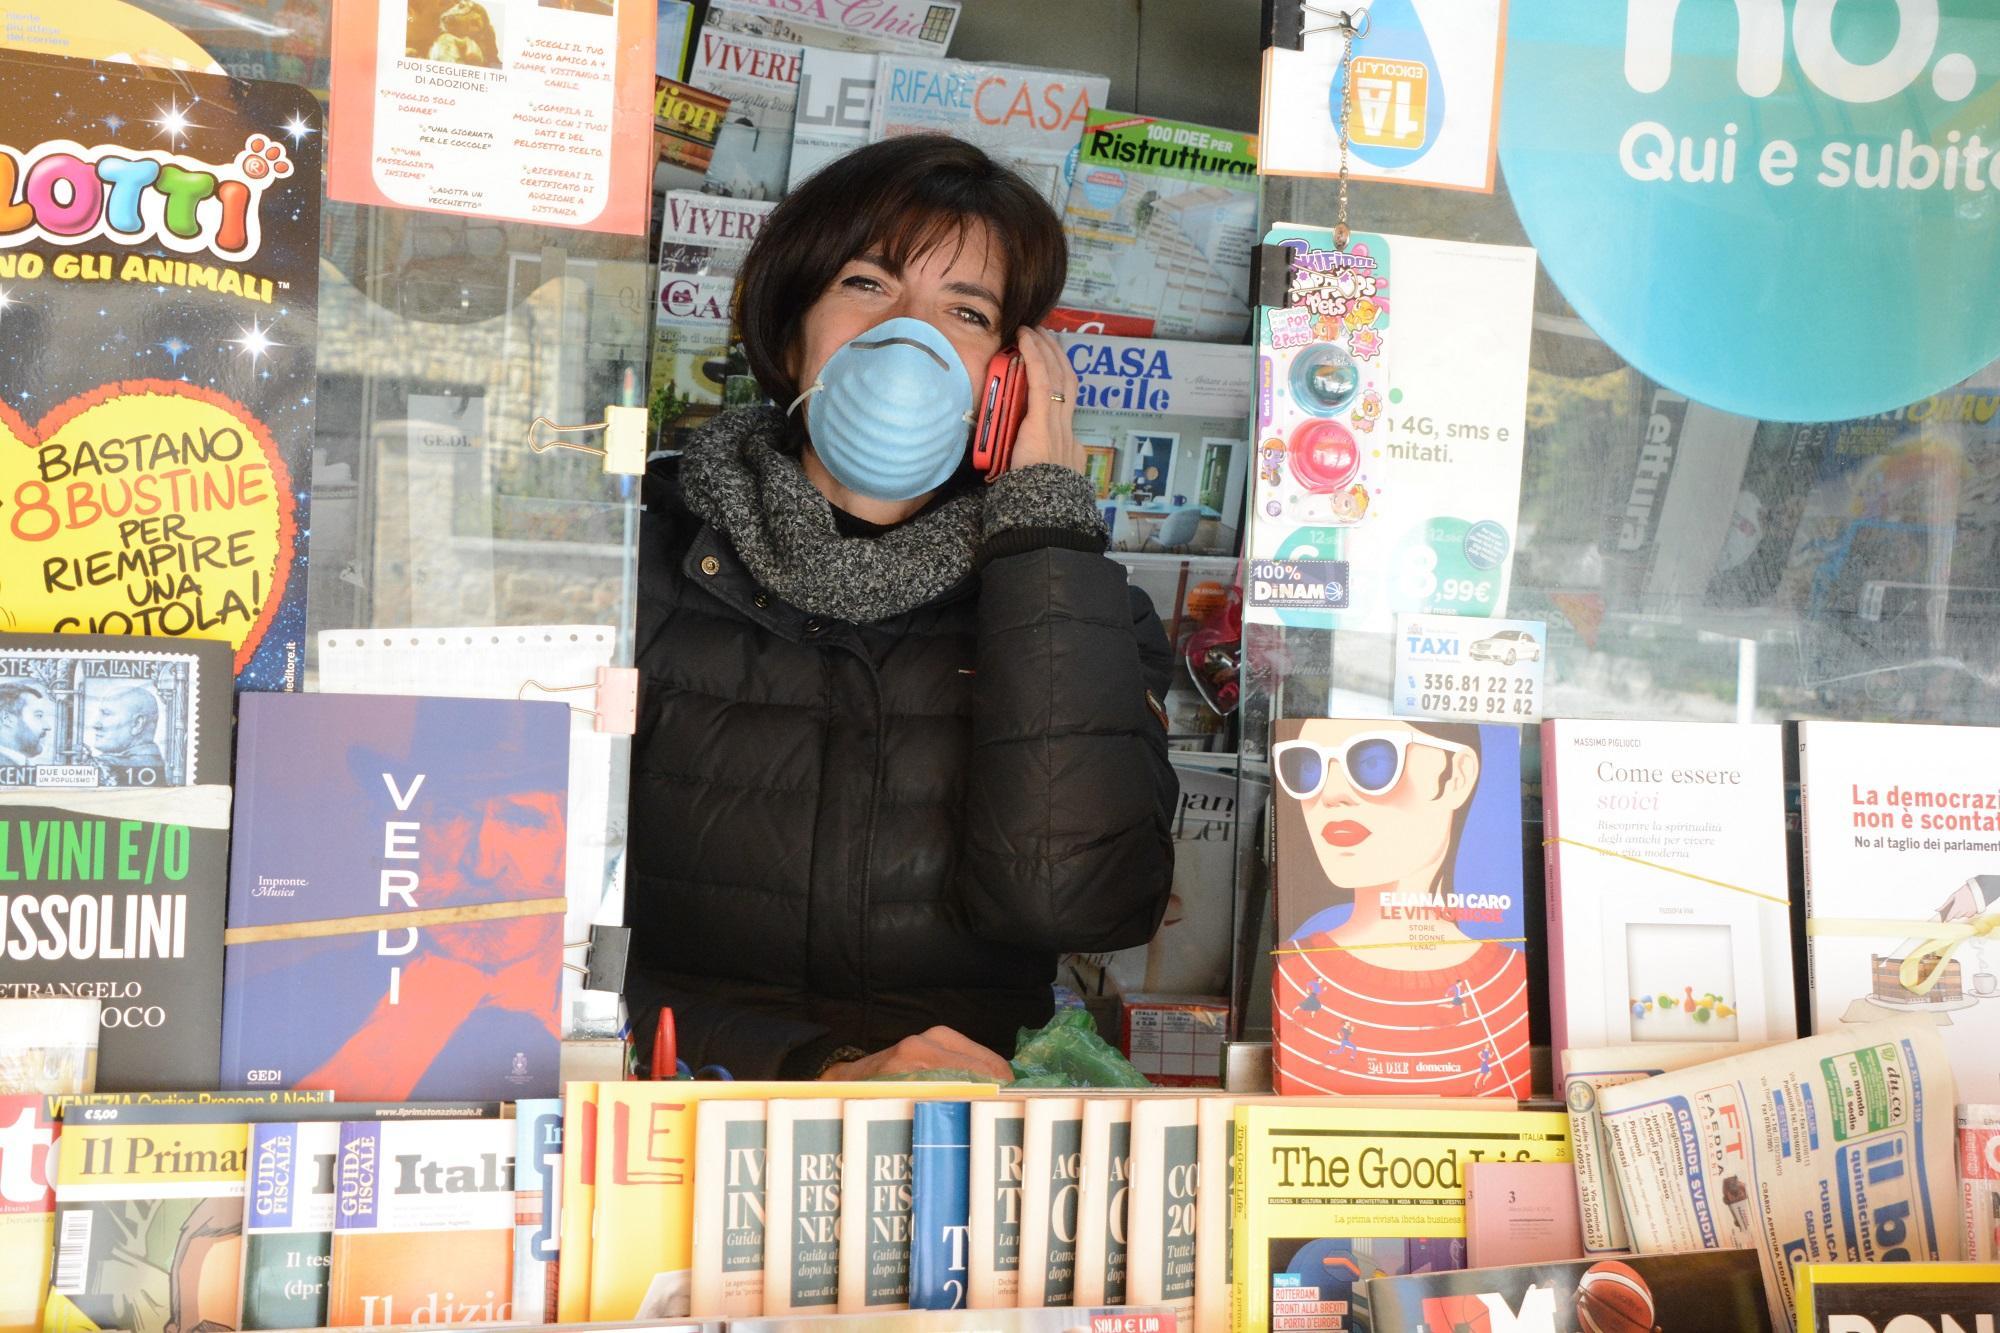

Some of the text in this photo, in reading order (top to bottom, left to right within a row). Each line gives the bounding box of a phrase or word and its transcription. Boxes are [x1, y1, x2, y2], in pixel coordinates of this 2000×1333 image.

[535, 39, 570, 51] SCEGLI
[522, 49, 588, 66] NUOVO AMICO
[397, 60, 508, 83] PUOI SCEGLIERE TIPI
[551, 67, 599, 80] VISITANDO
[1355, 60, 1425, 79] EDICOLA.IT
[429, 77, 488, 93] ADOZIONE:
[890, 67, 1090, 132] RIFARE CASA
[513, 113, 552, 125] MODULO
[538, 104, 580, 116] COMPILA
[450, 128, 493, 140] GIORNATA
[1147, 123, 1234, 154] 100 IDEE PER
[513, 139, 565, 152] PELOSETTO
[376, 156, 434, 169] PASSEGGIATA
[1619, 121, 2000, 192] Qui e subit
[532, 167, 581, 179] RICEVERAI
[437, 187, 469, 197] ADOTTA
[520, 178, 580, 192] CERTIFICATO
[528, 192, 575, 204] ADOZIONE
[532, 205, 577, 216] DISTANZA
[53, 255, 112, 280] GLI
[121, 256, 273, 304] ANIMALI
[1287, 313, 1309, 327] POP
[1283, 331, 1312, 346] Pets!
[1066, 343, 1173, 380] CASA
[1076, 376, 1170, 412] acile
[1402, 415, 1510, 442] 4G, sms e
[37, 427, 243, 483] BASTANO
[10, 463, 268, 542] 8 BUSTINE
[118, 514, 195, 549] PER
[43, 530, 256, 594] RIEMPIRE
[1253, 565, 1301, 580] 100%
[127, 573, 204, 607] UNA
[1407, 636, 1459, 656] TAXI
[1424, 673, 1534, 695] 336.81 22 22
[1421, 693, 1533, 715] 079.29 92 42
[1574, 738, 1641, 748] MASSIMO PIGLIUCCI
[39, 768, 97, 777] DUE UOMINI
[125, 767, 157, 786] 10
[1597, 760, 1742, 785] Come essere
[1597, 791, 1660, 811] stoici
[1852, 784, 1879, 805] La
[1598, 820, 1650, 833] Riscoprire
[1853, 807, 1913, 829] non è
[1598, 833, 1661, 845] degli antichi
[1855, 836, 1940, 852] No al taglio dei
[118, 820, 192, 885] E/O
[1644, 847, 1690, 859] moderna
[258, 874, 308, 888] Impronte
[377, 773, 426, 1005] VERDI
[251, 885, 297, 898] Musica
[1379, 891, 1511, 910] ELIANA DI CARO
[1381, 906, 1402, 920] LE
[0, 894, 187, 961] SSOLINI
[247, 1070, 281, 1083] GEDI
[1415, 1061, 1462, 1073] domenica
[1854, 1080, 1865, 1117] mondo
[1847, 1101, 1857, 1130] sedie
[1522, 1133, 1544, 1142] ITALIA
[1629, 1120, 1645, 1157] Piumoni
[1643, 1117, 1658, 1149] Articoli
[1651, 1114, 1663, 1143] Intimo
[1704, 1093, 1725, 1176] FAEDDA
[1719, 1104, 1744, 1160] FT
[1611, 1124, 1630, 1168] Materassi
[1665, 1111, 1684, 1176] Abbigliamento
[1677, 1109, 1699, 1175] GRANDE
[80, 1136, 114, 1175] Il
[1866, 1137, 1905, 1186] il
[256, 1135, 278, 1216] GUIDA
[272, 1134, 292, 1215] FISCALE
[341, 1136, 362, 1217] GUIDA
[357, 1135, 376, 1215] FISCALE
[1272, 1146, 1462, 1189] The Good
[1346, 1215, 1461, 1225] prima rivista ibrida business
[1767, 1216, 1781, 1260] APERTURA
[1804, 1210, 1821, 1258] CAGLIARI
[287, 1252, 301, 1268] Il
[798, 1250, 827, 1263] Guida
[873, 1250, 900, 1262] Guida
[1167, 1245, 1190, 1259] Tutte
[798, 1263, 820, 1279] dopo
[873, 1263, 894, 1278] dopo
[1049, 1265, 1072, 1280] dopo
[284, 1280, 323, 1301] (dpr
[360, 1294, 393, 1328] Il
[1275, 1303, 1319, 1314] PRONTI ALLA
[1094, 1318, 1159, 1333] SOLO 1,00
[1282, 1317, 1341, 1329] PORTO D'EUROPA
